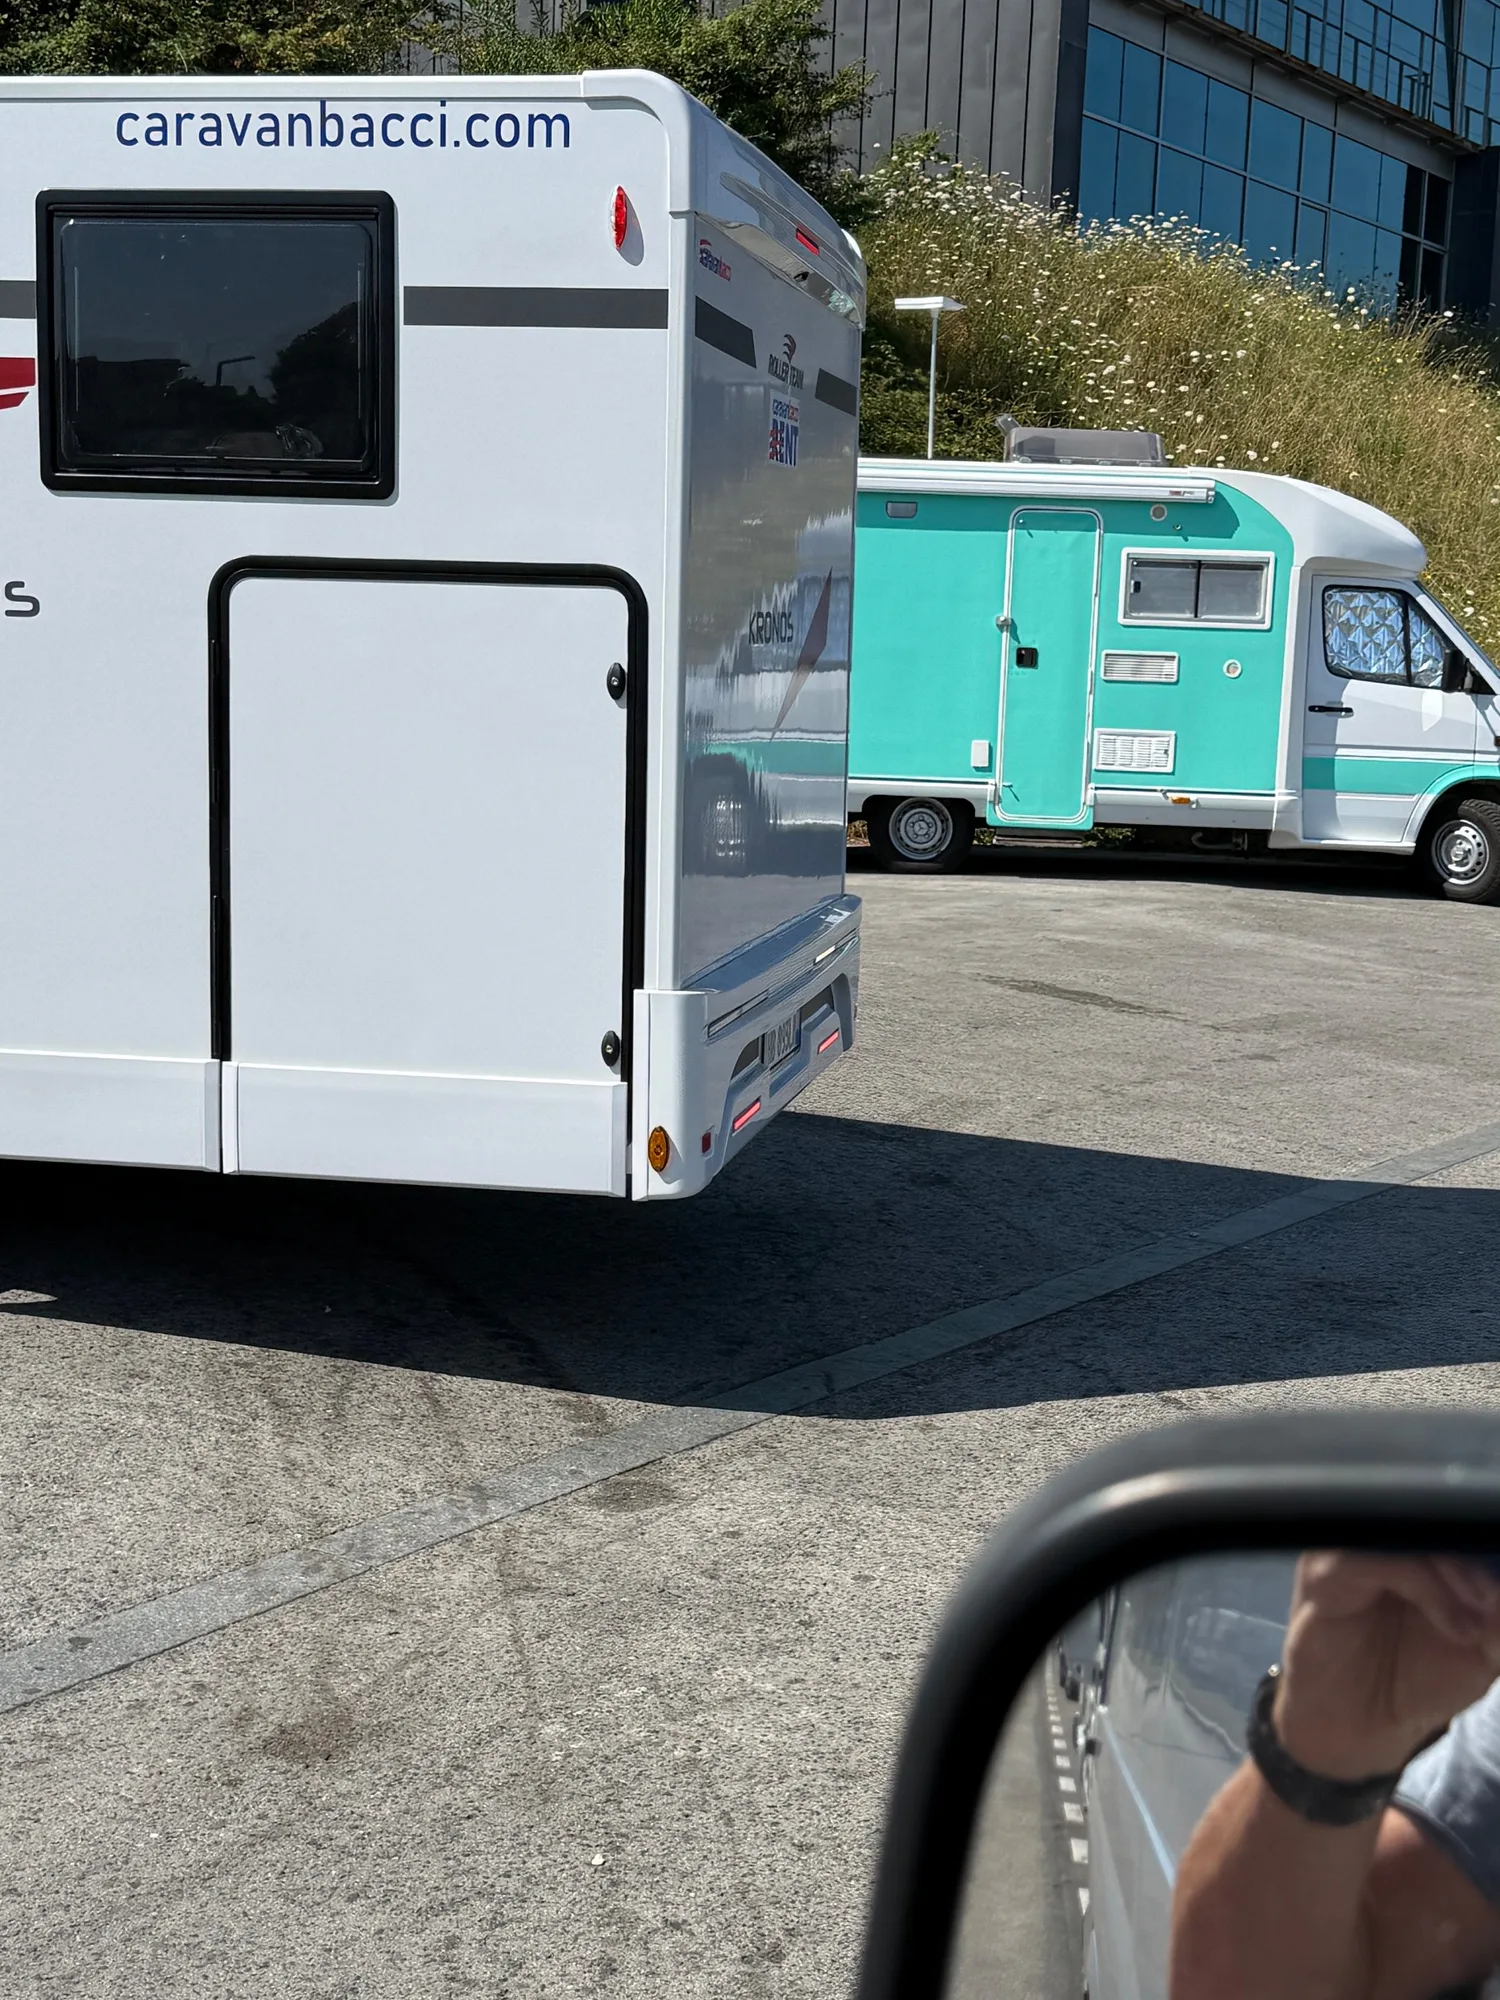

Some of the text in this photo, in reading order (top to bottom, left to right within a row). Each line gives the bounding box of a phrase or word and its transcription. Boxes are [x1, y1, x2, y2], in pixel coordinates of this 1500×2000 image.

[116, 100, 571, 148] caravanbacci.com
[768, 354, 789, 384] ROLLER
[748, 611, 794, 645] KRONOS
